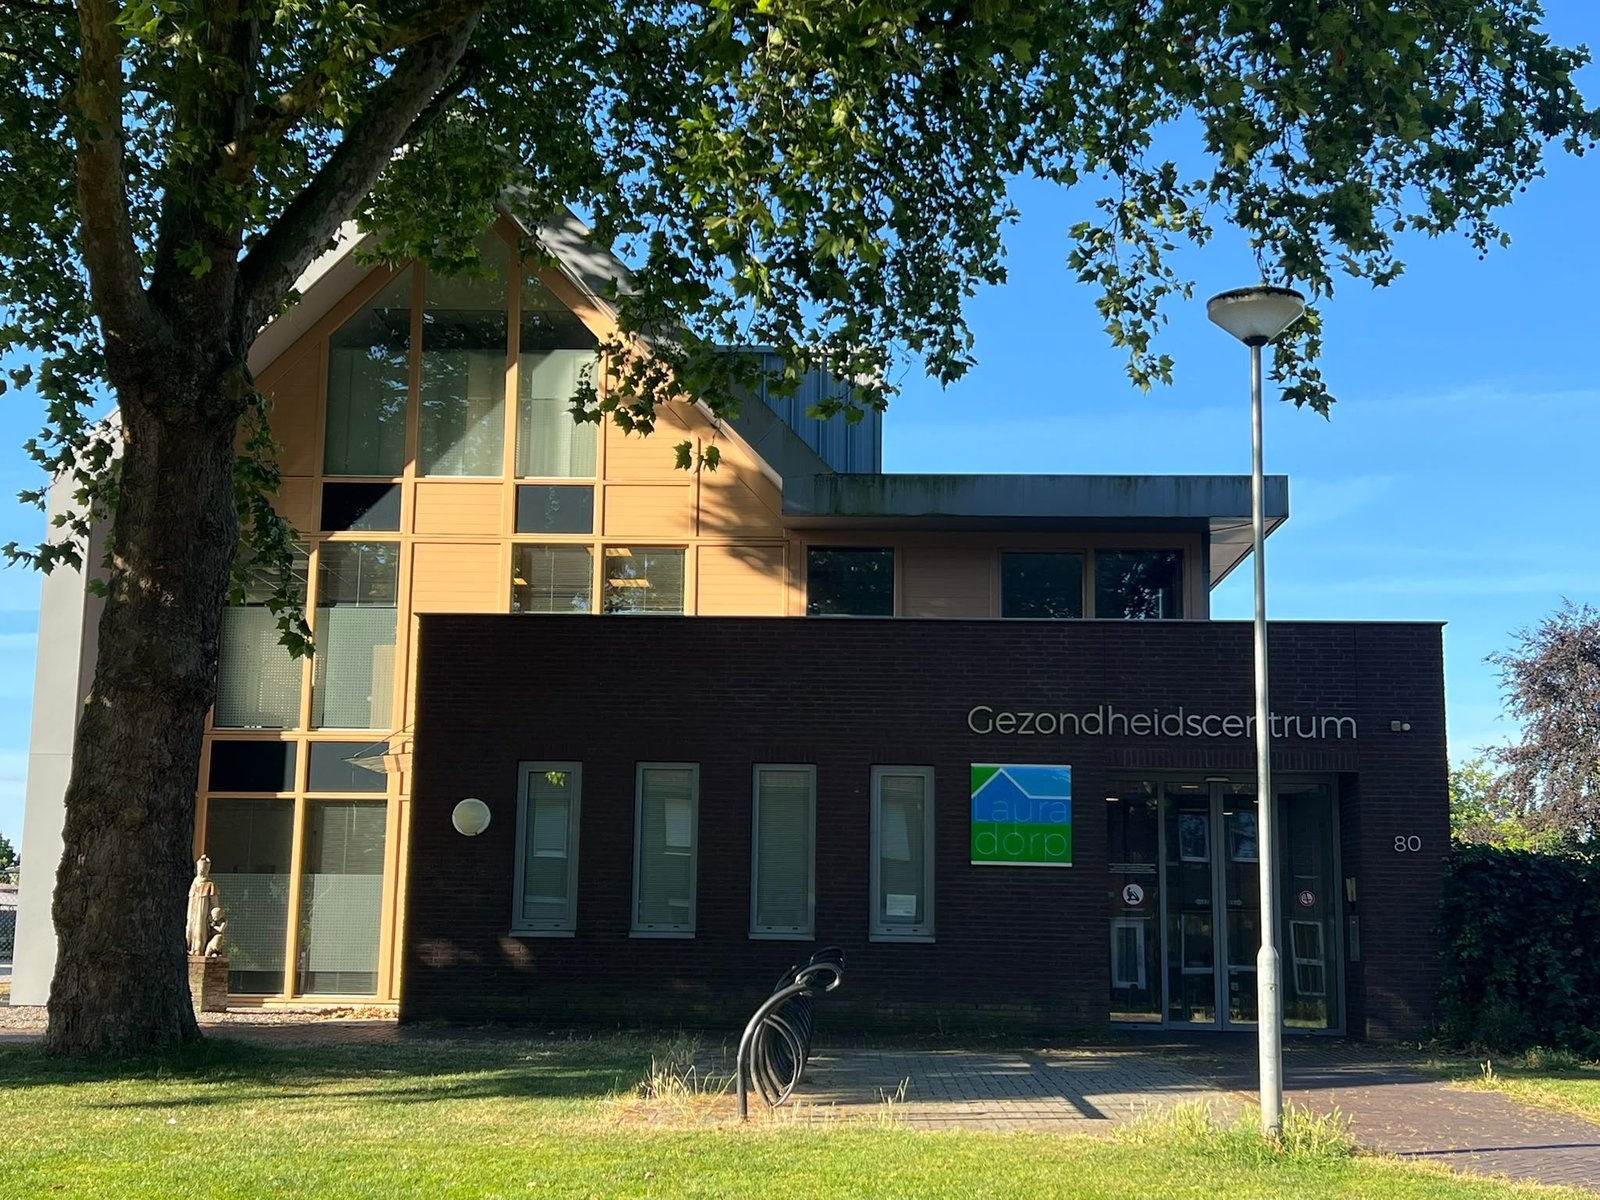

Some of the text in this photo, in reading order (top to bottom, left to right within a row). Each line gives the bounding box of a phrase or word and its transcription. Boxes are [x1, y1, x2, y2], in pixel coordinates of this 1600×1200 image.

[974, 798, 1067, 823] Laura
[975, 823, 1067, 862] dorp
[1394, 835, 1422, 852] 80
